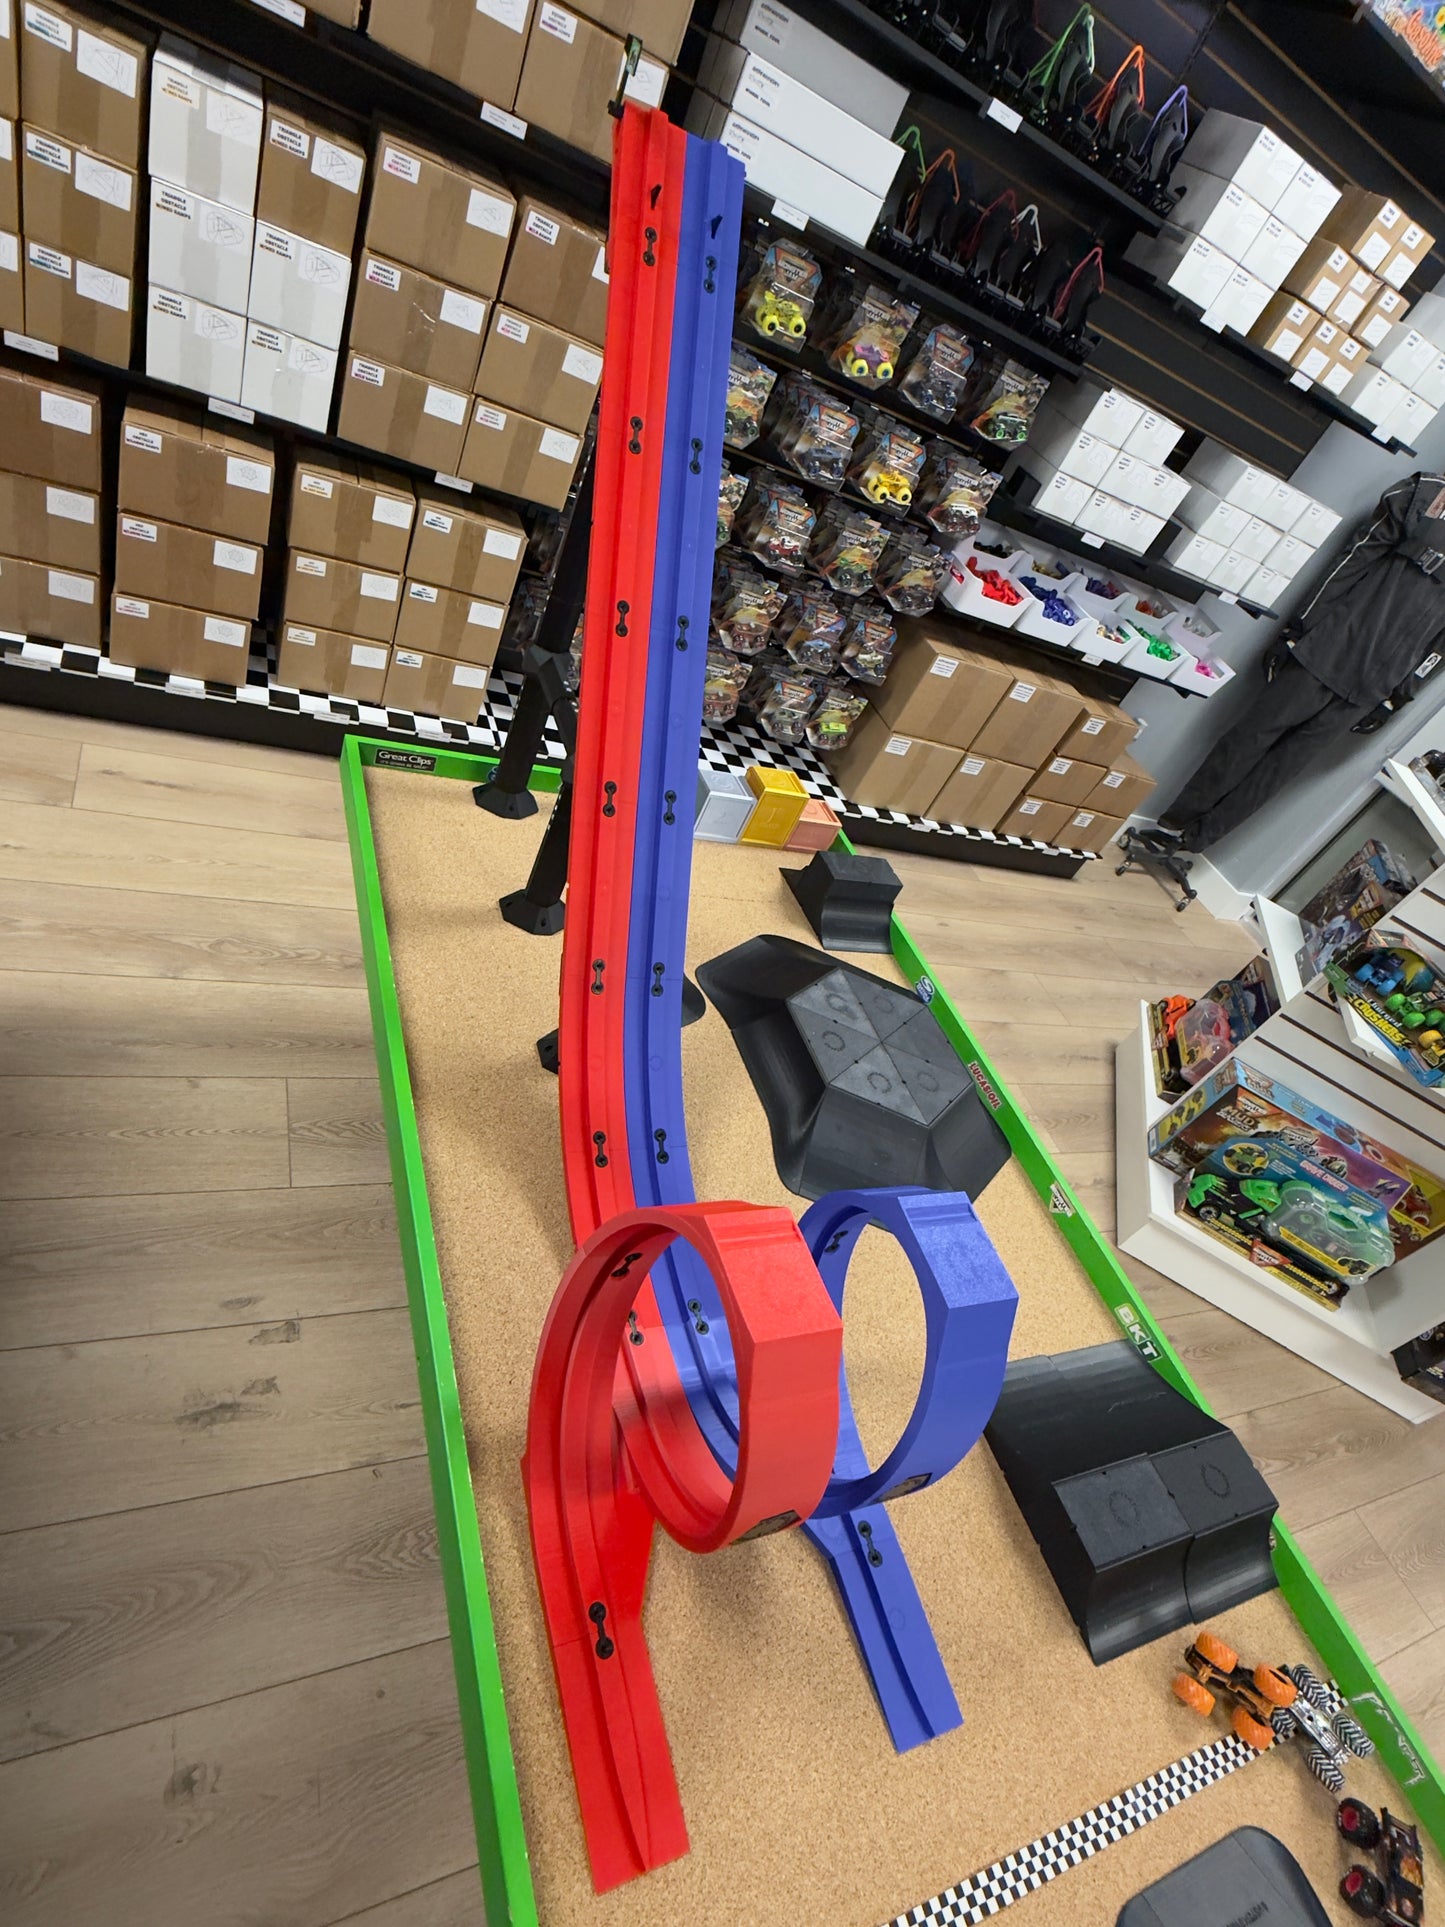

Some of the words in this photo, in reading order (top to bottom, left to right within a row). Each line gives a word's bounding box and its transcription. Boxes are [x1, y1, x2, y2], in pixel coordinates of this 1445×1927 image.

[378, 751, 408, 762] Great
[408, 755, 432, 766] Clips
[1353, 998, 1406, 1042] CRUSHERS
[968, 1061, 991, 1092] LUCAS
[987, 1092, 1001, 1110] OIL
[1219, 1105, 1257, 1128] MUD
[1117, 1304, 1159, 1358] BKT
